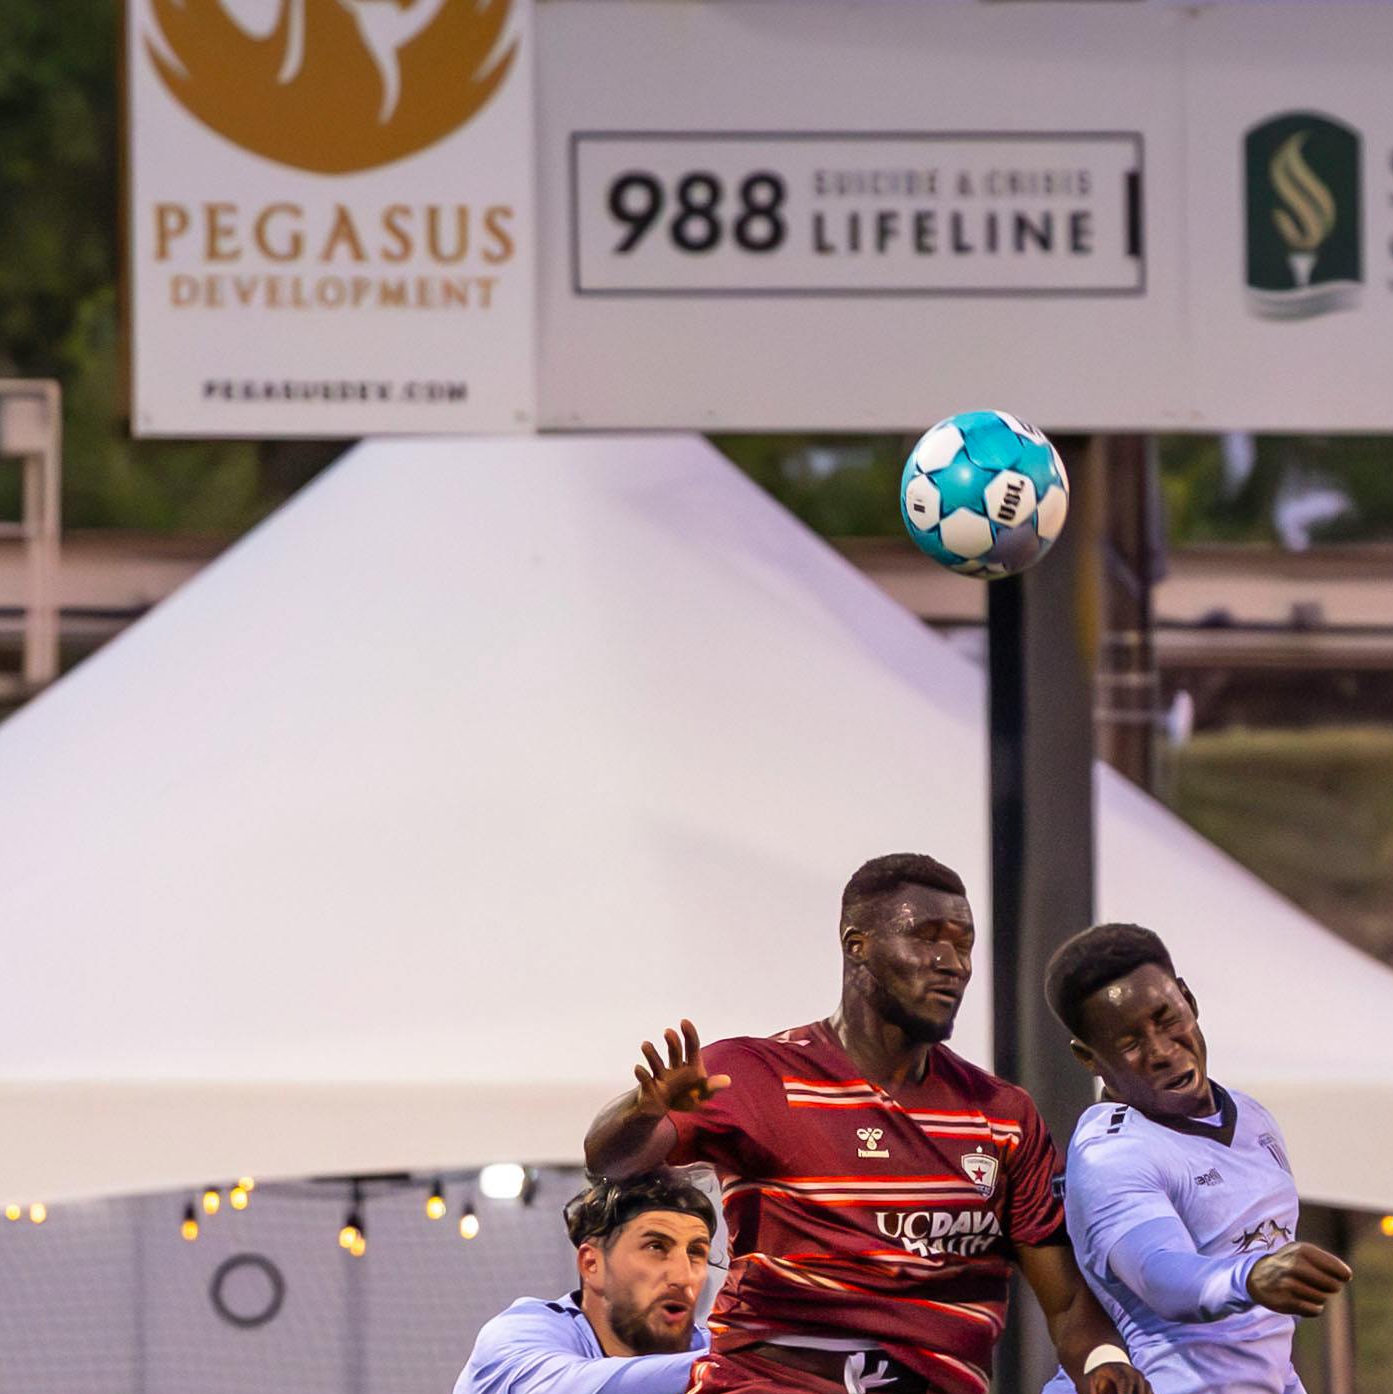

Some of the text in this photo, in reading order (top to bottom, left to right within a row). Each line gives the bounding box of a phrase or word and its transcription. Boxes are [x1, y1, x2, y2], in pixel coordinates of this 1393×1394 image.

[152, 202, 517, 265] PEGASUS
[605, 168, 789, 256] 988
[812, 209, 1094, 255] LIFELINE
[169, 273, 499, 310] DEVELOPMENT
